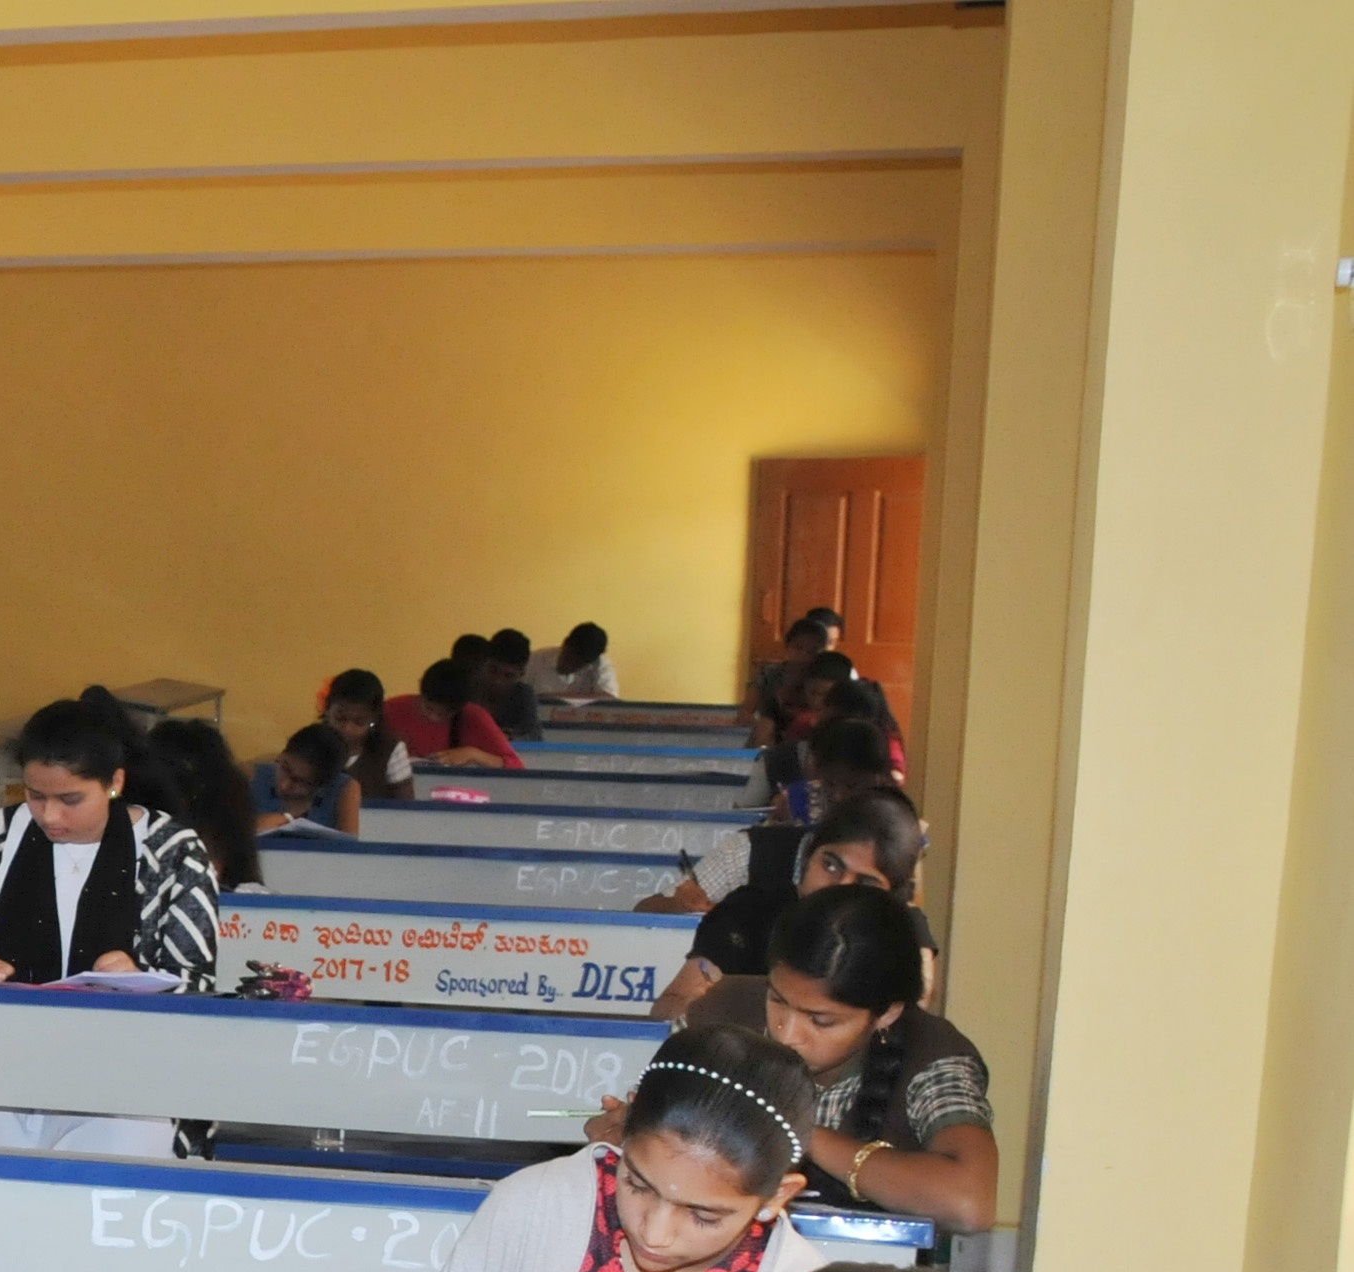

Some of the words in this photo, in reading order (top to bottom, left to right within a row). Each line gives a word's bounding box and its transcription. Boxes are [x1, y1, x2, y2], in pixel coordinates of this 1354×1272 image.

[311, 956, 411, 984] 2017-18
[435, 969, 529, 997] Sponsored
[571, 962, 658, 1002] DISA
